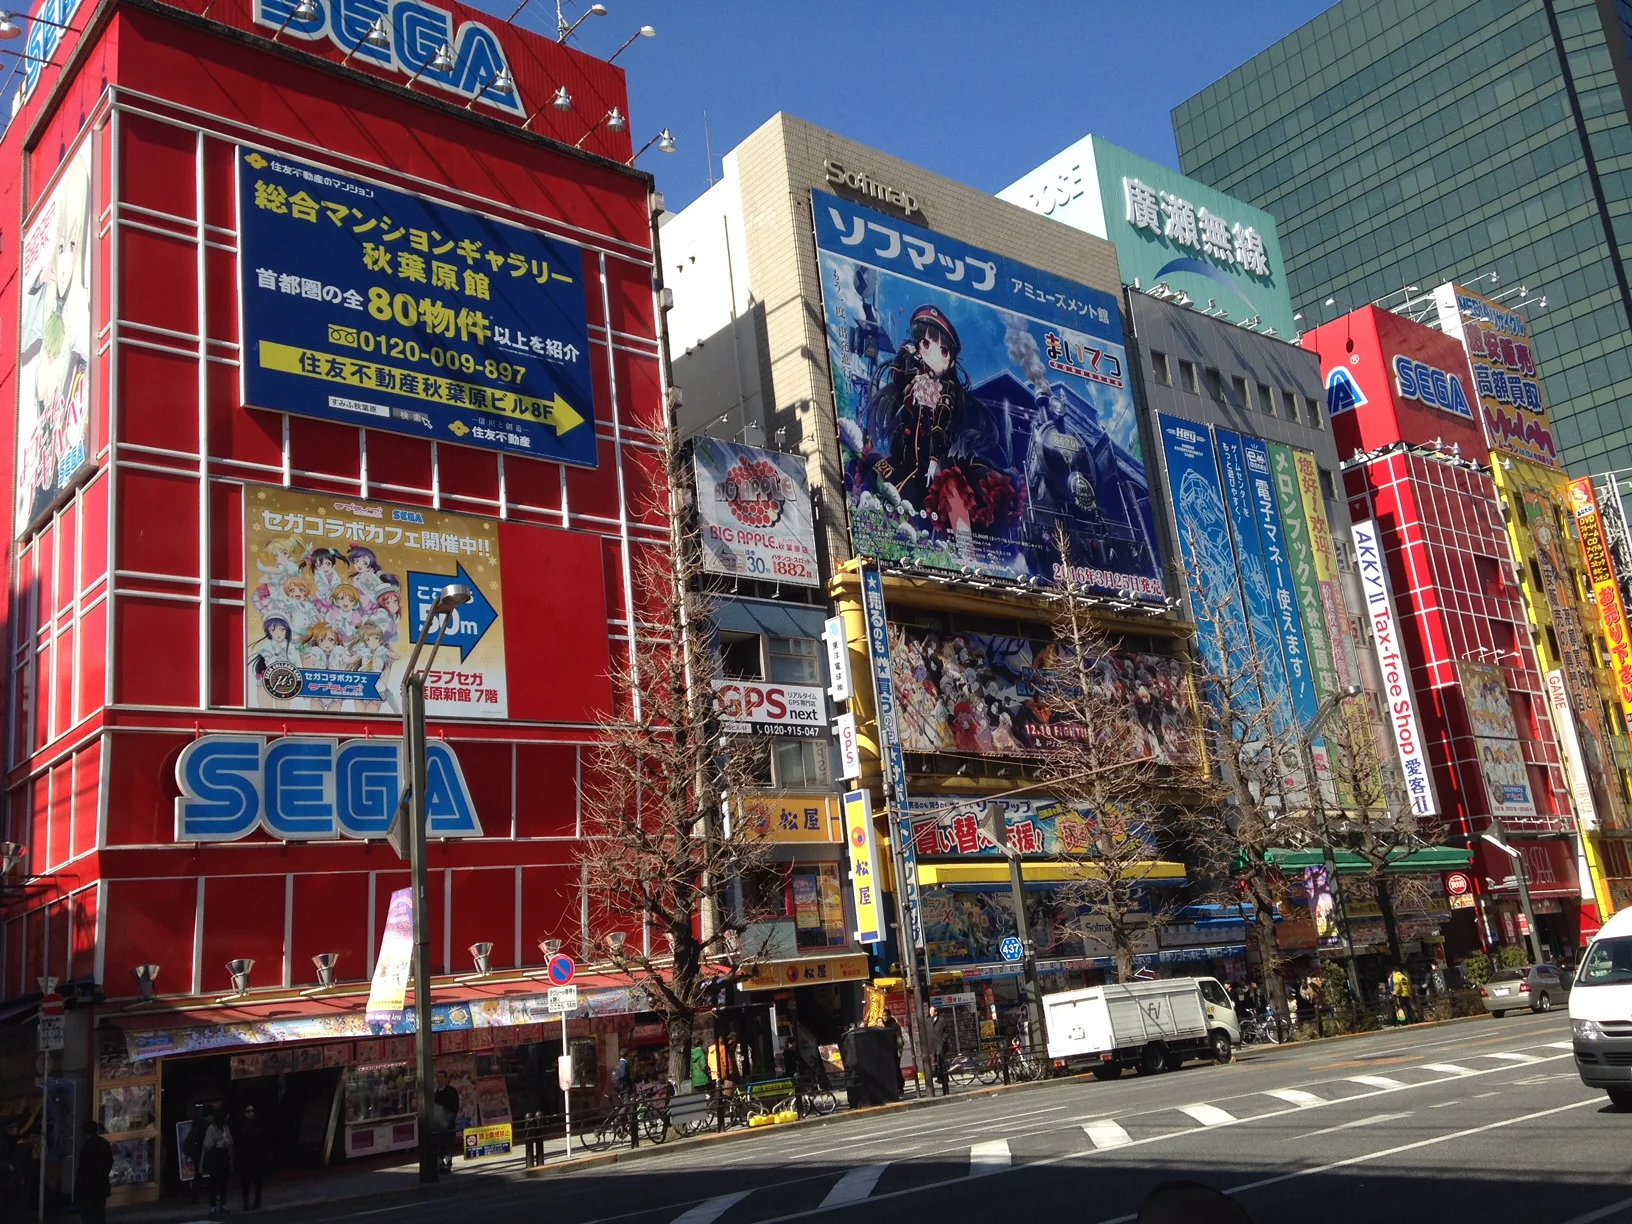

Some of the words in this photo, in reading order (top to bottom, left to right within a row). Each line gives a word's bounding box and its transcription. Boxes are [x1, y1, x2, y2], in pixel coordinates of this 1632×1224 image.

[270, 160, 374, 198] 住友不動産のマンション
[823, 158, 919, 215] Sofmap
[254, 179, 573, 284] 総合マンションギャラリー
[1122, 176, 1270, 276] 廣瀬無線
[828, 206, 997, 291] ソフマップ
[362, 242, 491, 300] 秋葉原館
[1011, 277, 1110, 325] アミューズメント館
[360, 331, 526, 384] 0120-009-897
[1045, 332, 1122, 378] まいてつ
[299, 351, 554, 420] 住友不動産秋葉原ビル8F
[1393, 354, 1475, 421] SEGA
[331, 398, 377, 413] すみふ秋葉原
[471, 426, 531, 448] 住友不動産
[714, 479, 738, 502] BIG
[741, 475, 796, 501] APPLE
[261, 508, 491, 557] セガコラボカフェ開催中!!
[392, 509, 424, 524] SEGA
[710, 525, 734, 542] BIG
[1580, 516, 1595, 525] DVD
[1587, 538, 1598, 546] CD
[1255, 479, 1304, 698] 電子マネー使えます!
[1276, 452, 1335, 694] メロンブックス秋葉原店
[1356, 530, 1382, 588] AKKY
[1373, 606, 1402, 696] Tax-free
[1393, 699, 1416, 755] Shop
[305, 672, 368, 683] セガコラボカフェ
[1550, 677, 1567, 711] GAME
[716, 684, 787, 719] GPS
[790, 709, 818, 720] next
[764, 724, 819, 736] 0120-915-047
[843, 727, 854, 764] GPS
[174, 734, 484, 842] SEGA
[780, 807, 820, 830] 松屋
[856, 859, 872, 905] 松屋
[1002, 942, 1019, 954] 437
[804, 965, 827, 979] 松屋
